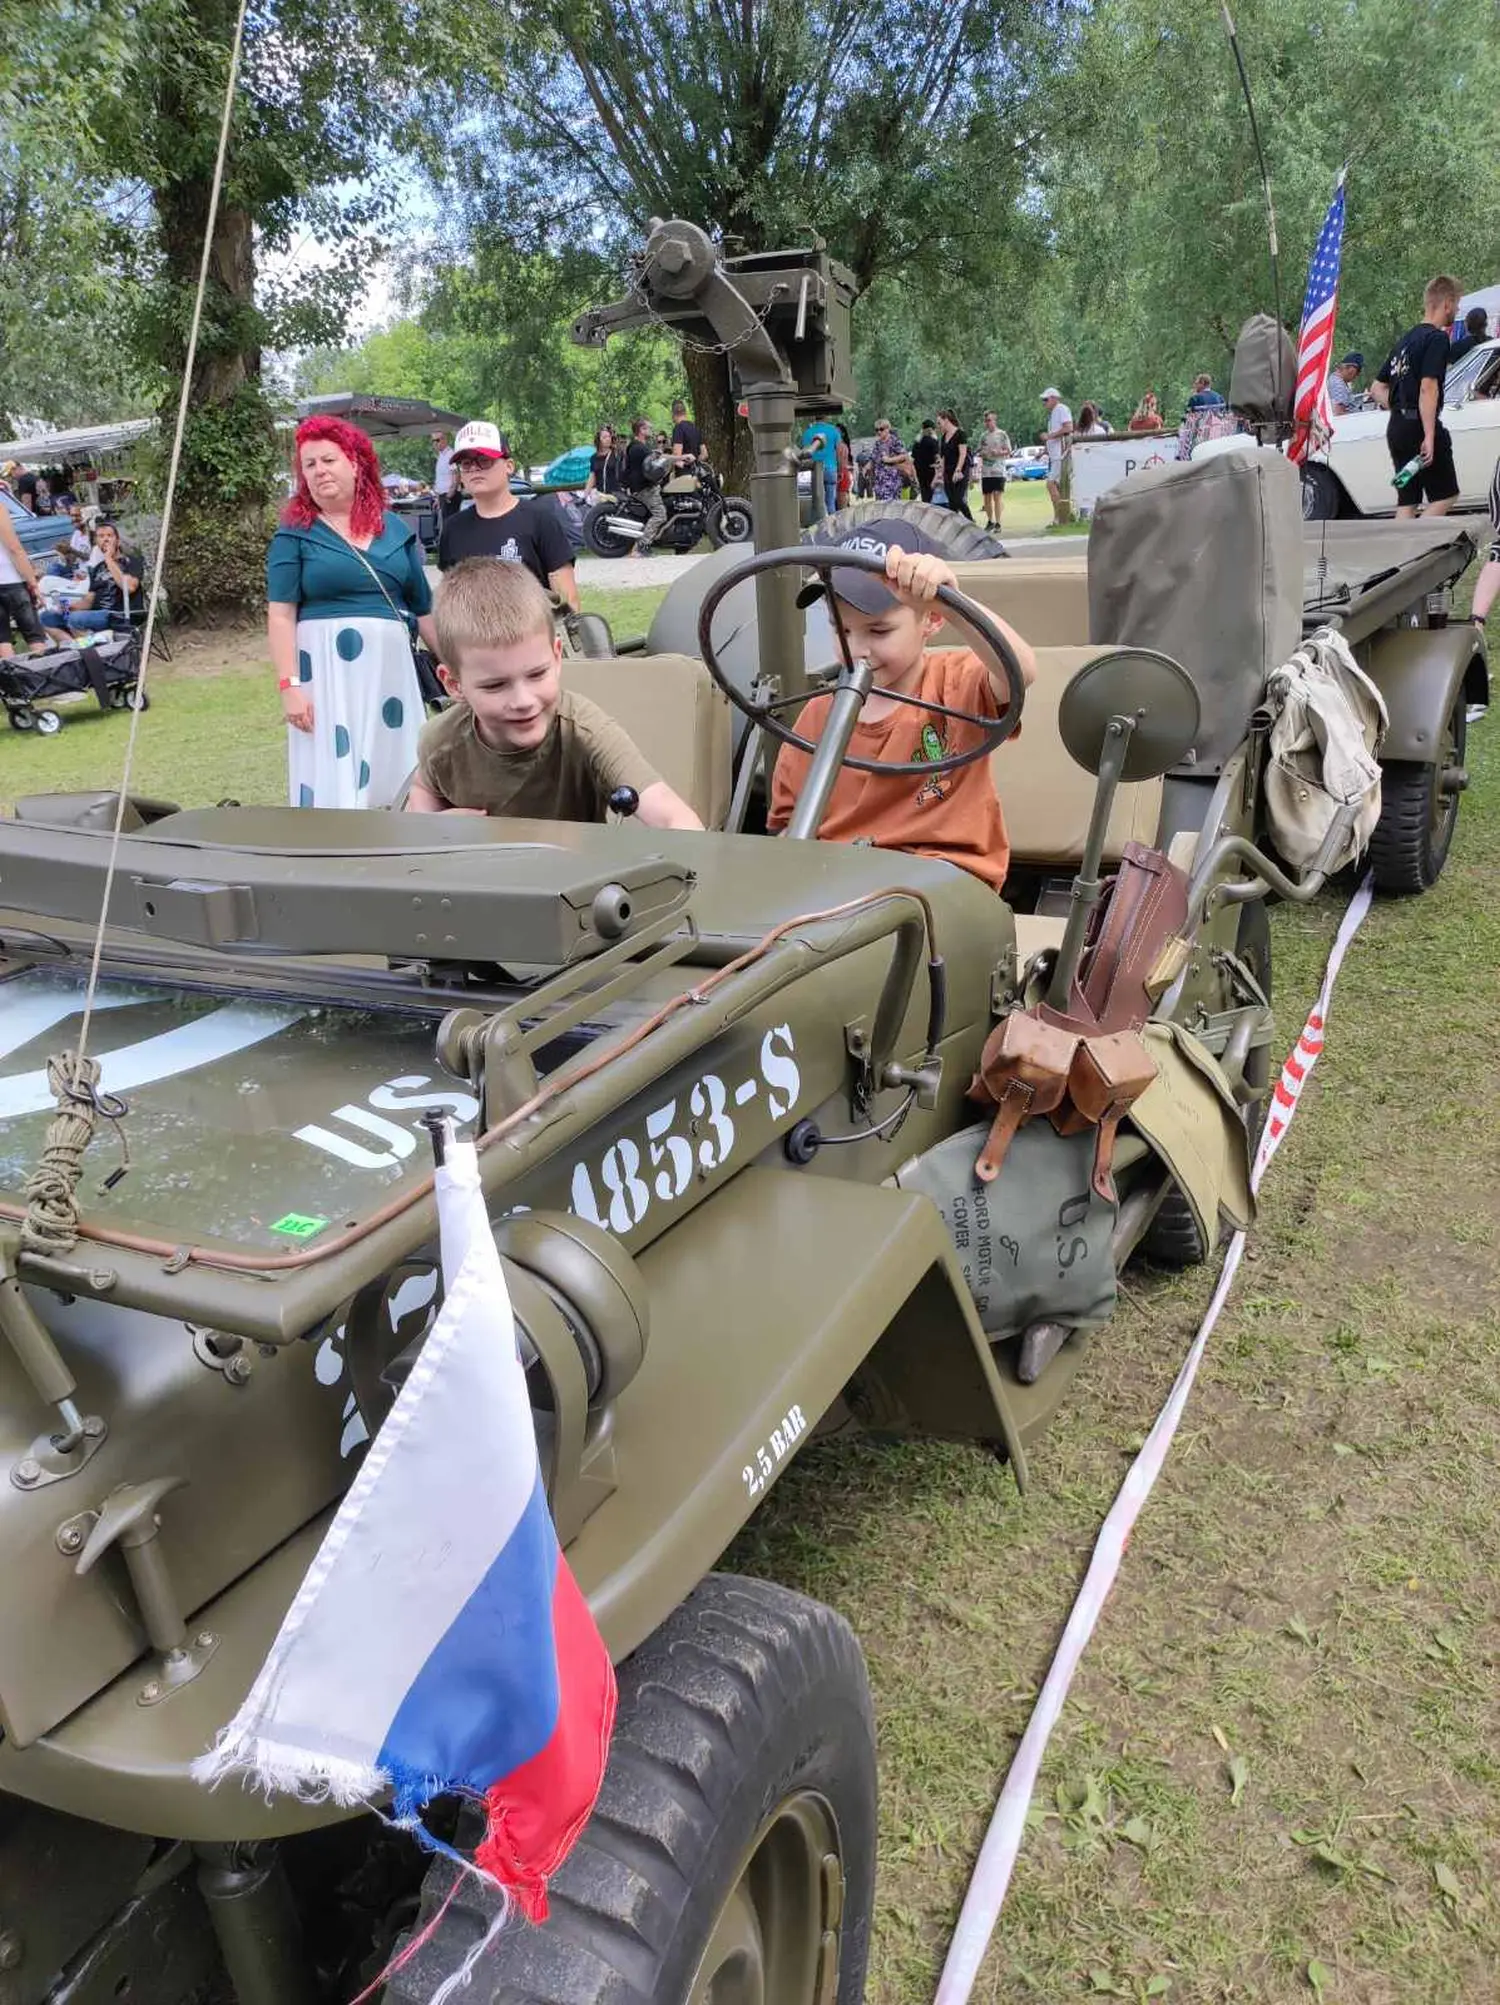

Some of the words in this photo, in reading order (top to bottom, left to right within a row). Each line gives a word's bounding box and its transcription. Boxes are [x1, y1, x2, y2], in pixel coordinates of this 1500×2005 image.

[291, 1075, 480, 1168] US
[952, 1195, 970, 1250] COVER
[971, 1185, 990, 1230] FORD
[977, 1235, 992, 1287] MOTOR
[742, 1446, 773, 1497] 2,5
[769, 1404, 807, 1462] BAR
